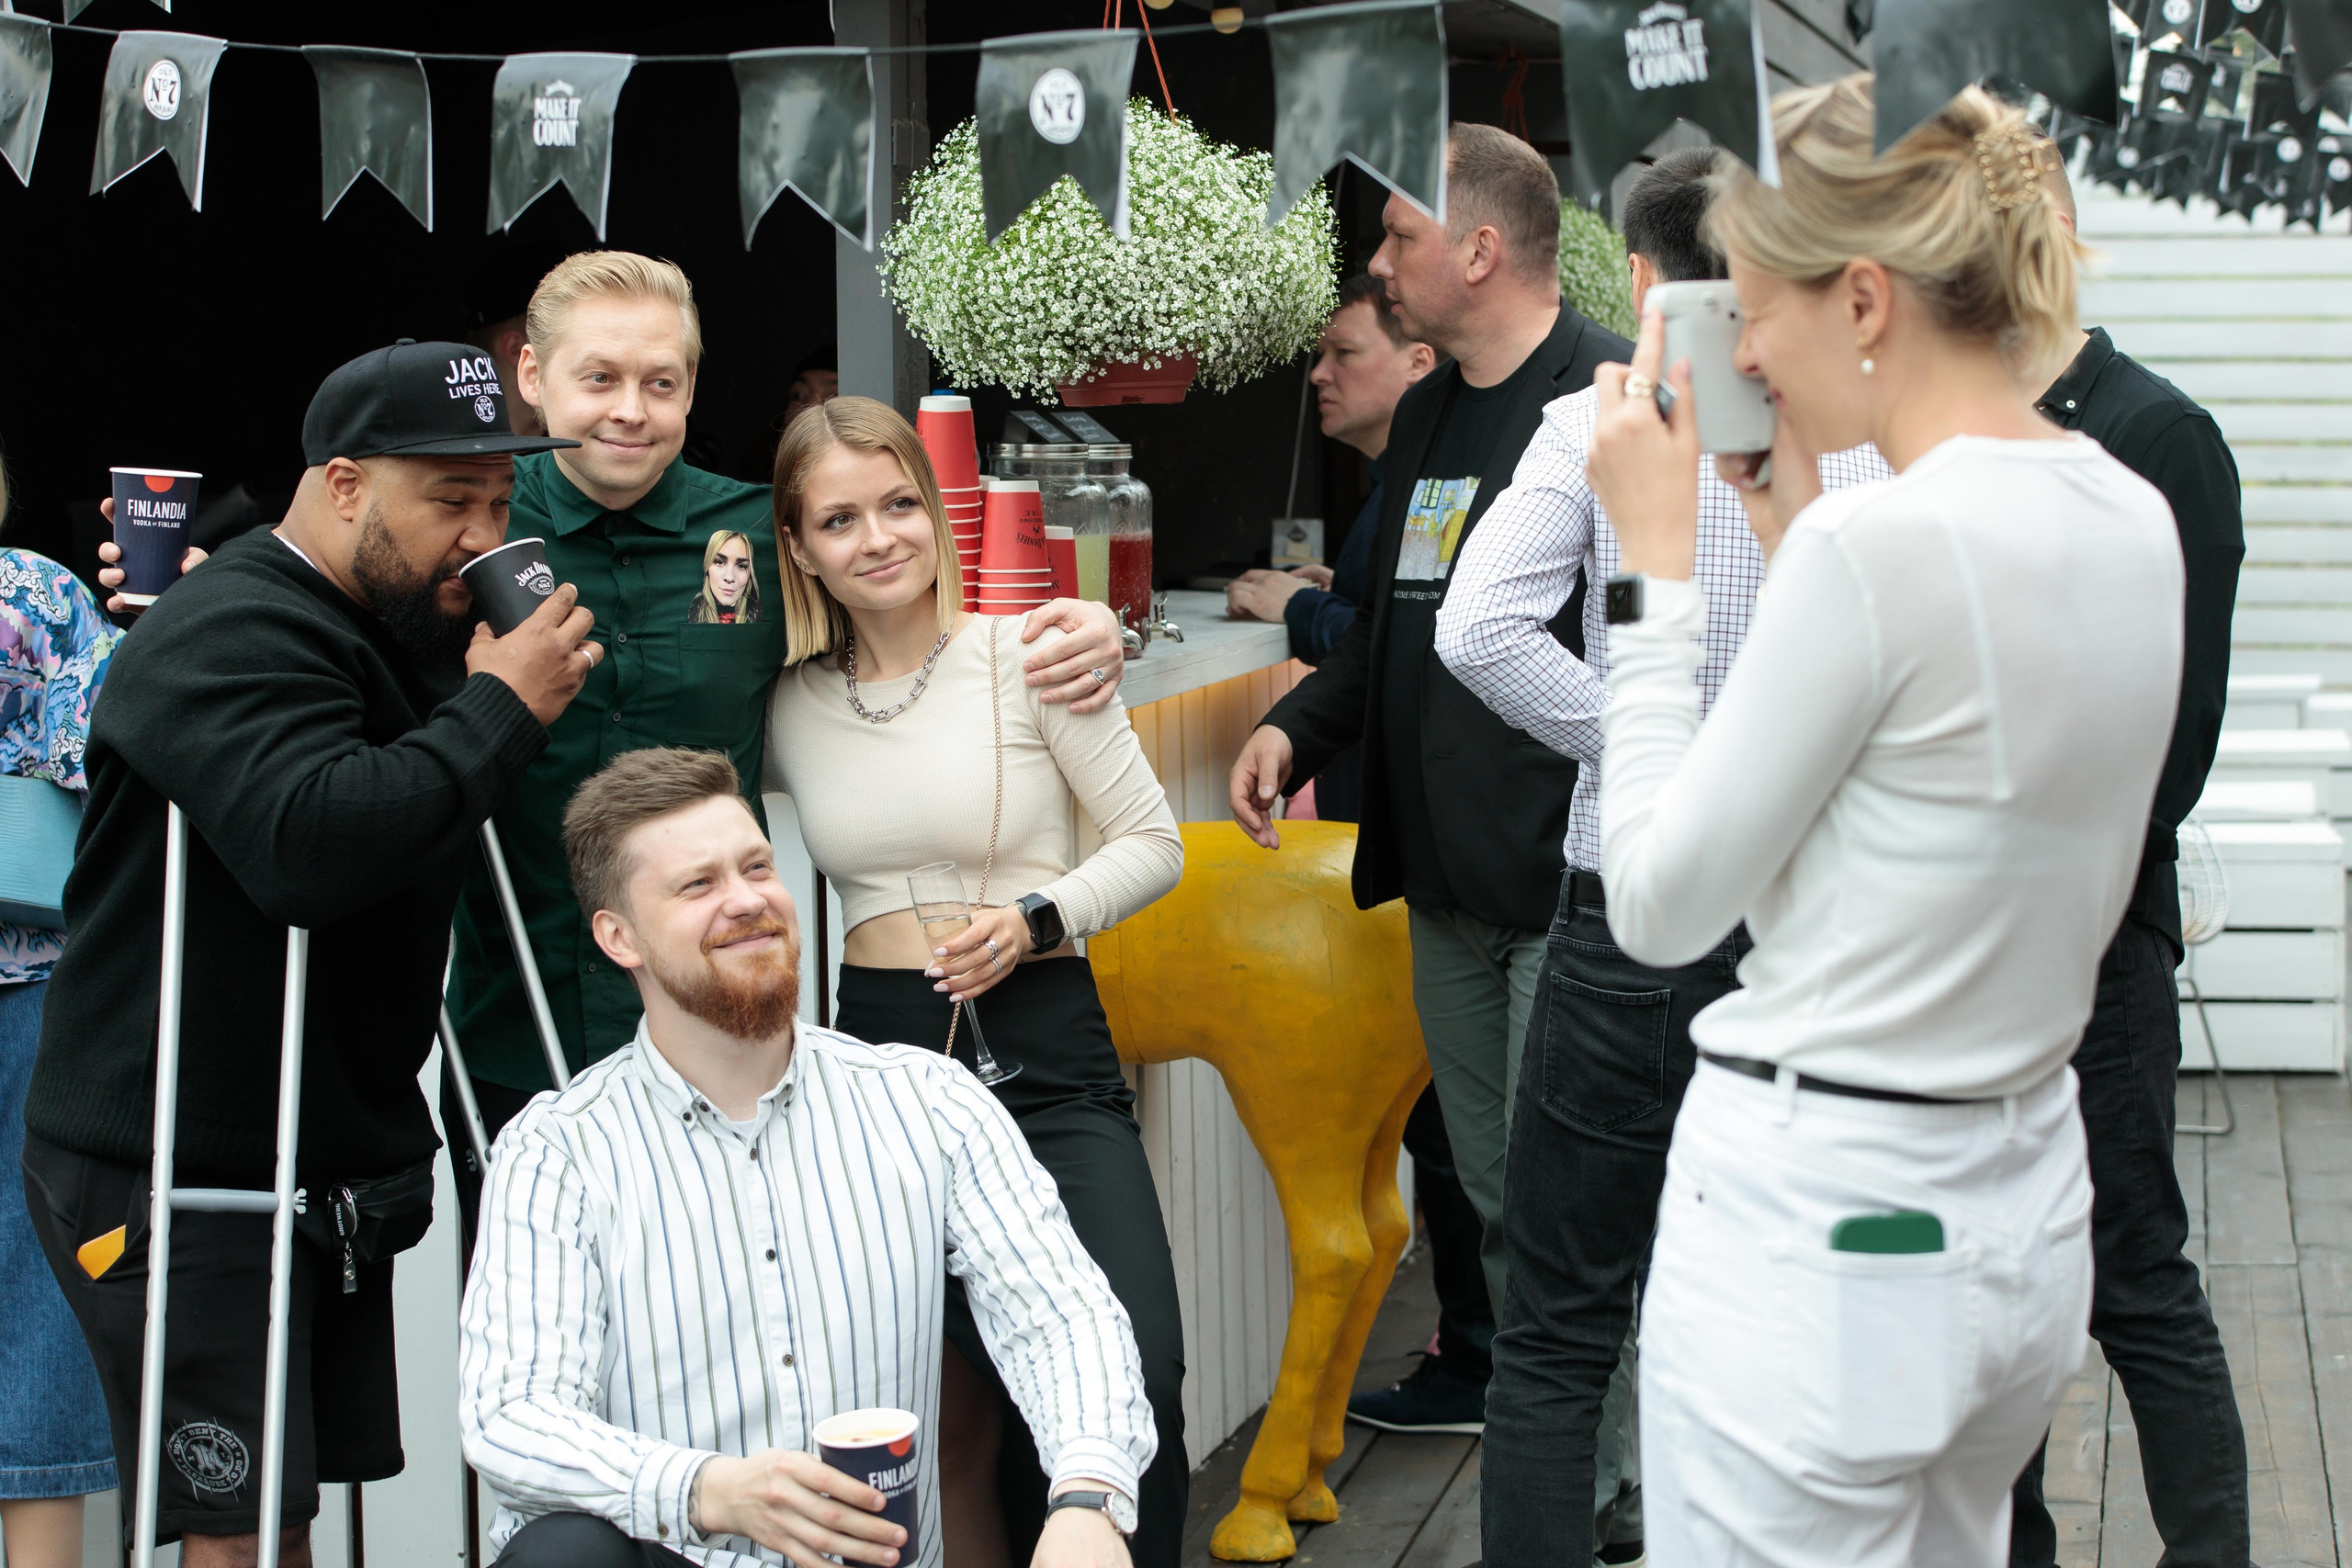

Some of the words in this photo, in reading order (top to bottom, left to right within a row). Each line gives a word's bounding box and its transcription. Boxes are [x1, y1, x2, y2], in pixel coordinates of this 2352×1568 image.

[1624, 22, 1683, 57] MAKE
[1681, 18, 1704, 48] IT
[1628, 45, 1709, 91] COUNT
[534, 97, 568, 119] MAKE
[568, 97, 582, 119] IT
[533, 118, 580, 147] COUNT
[445, 357, 497, 384] JACK
[448, 384, 481, 399] LIVES
[127, 499, 187, 520] FINLANDIA
[132, 519, 152, 527] VODKA
[514, 565, 537, 587] JACK
[219, 1432, 239, 1450] THE
[234, 1459, 243, 1472] DO
